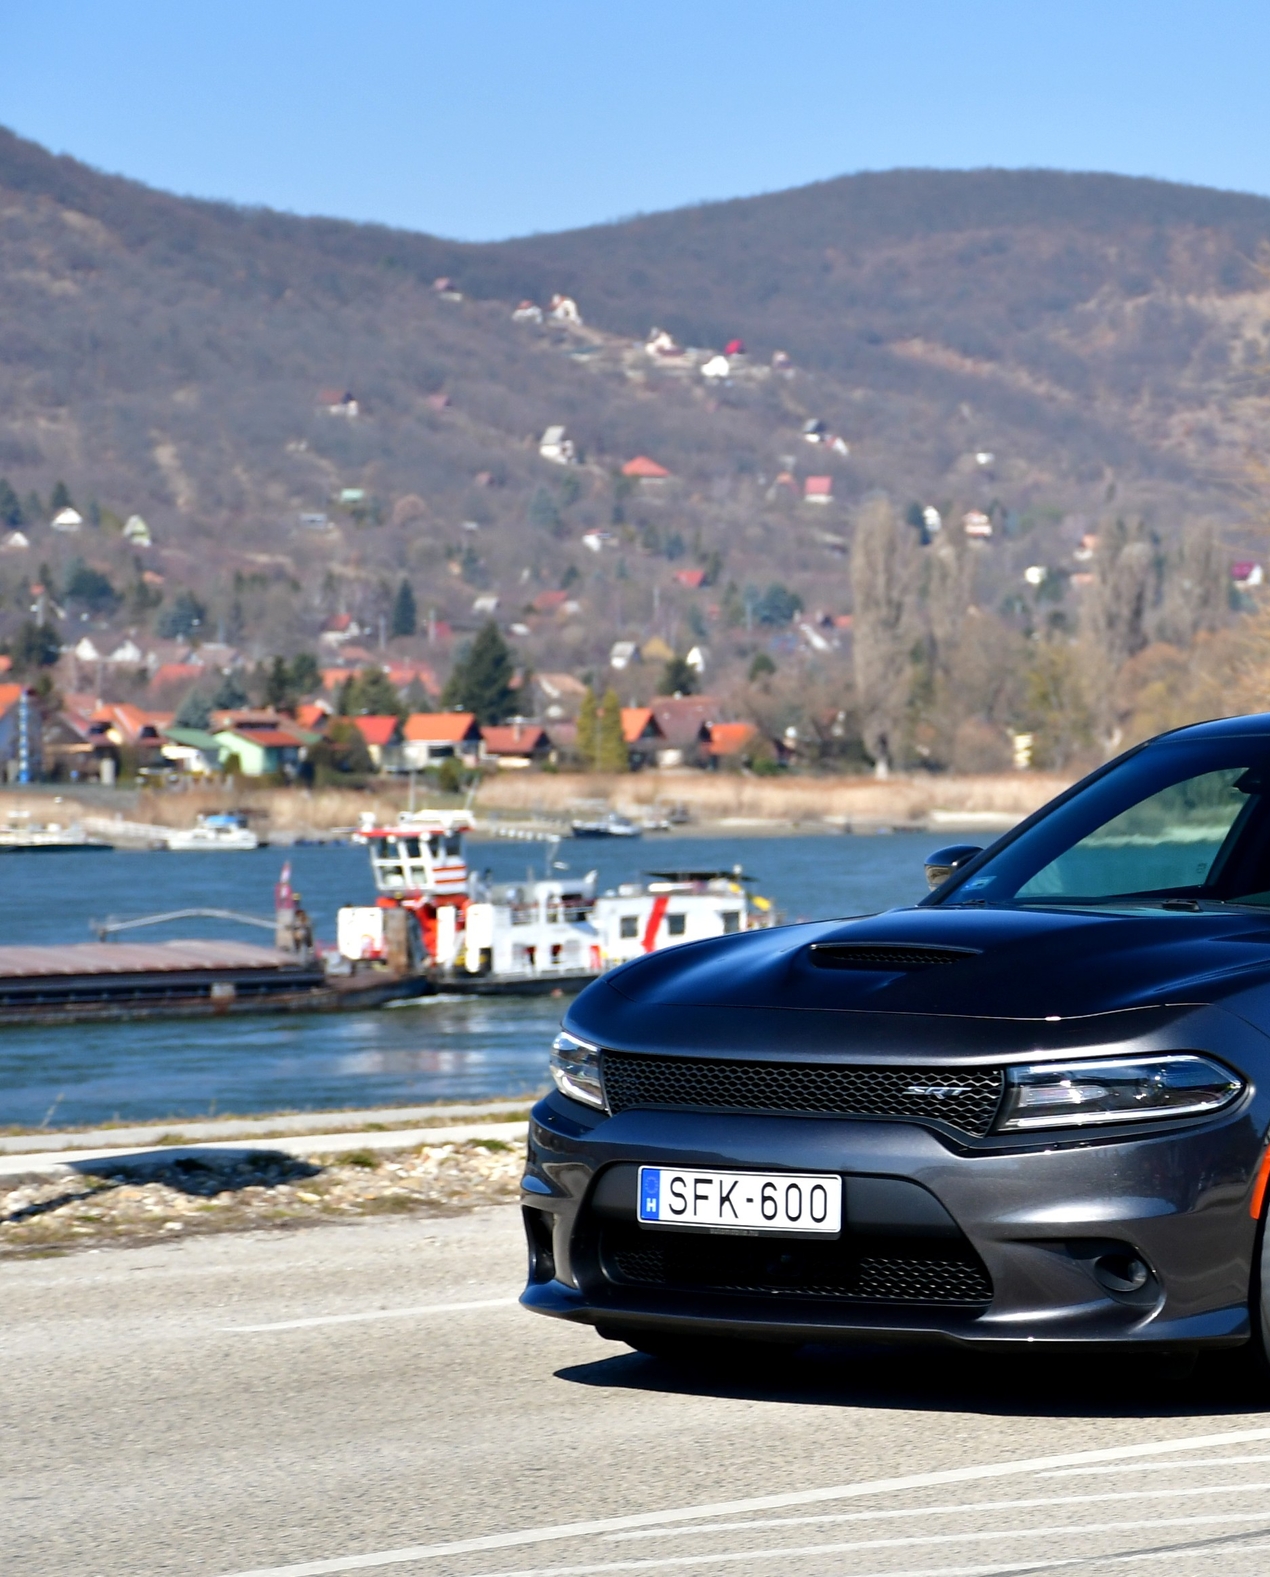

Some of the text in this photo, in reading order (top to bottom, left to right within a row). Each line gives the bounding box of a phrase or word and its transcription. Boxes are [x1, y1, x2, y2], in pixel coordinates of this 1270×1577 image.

[902, 1086, 972, 1100] SRT
[646, 1198, 657, 1213] H
[668, 1176, 828, 1224] SFK-600
